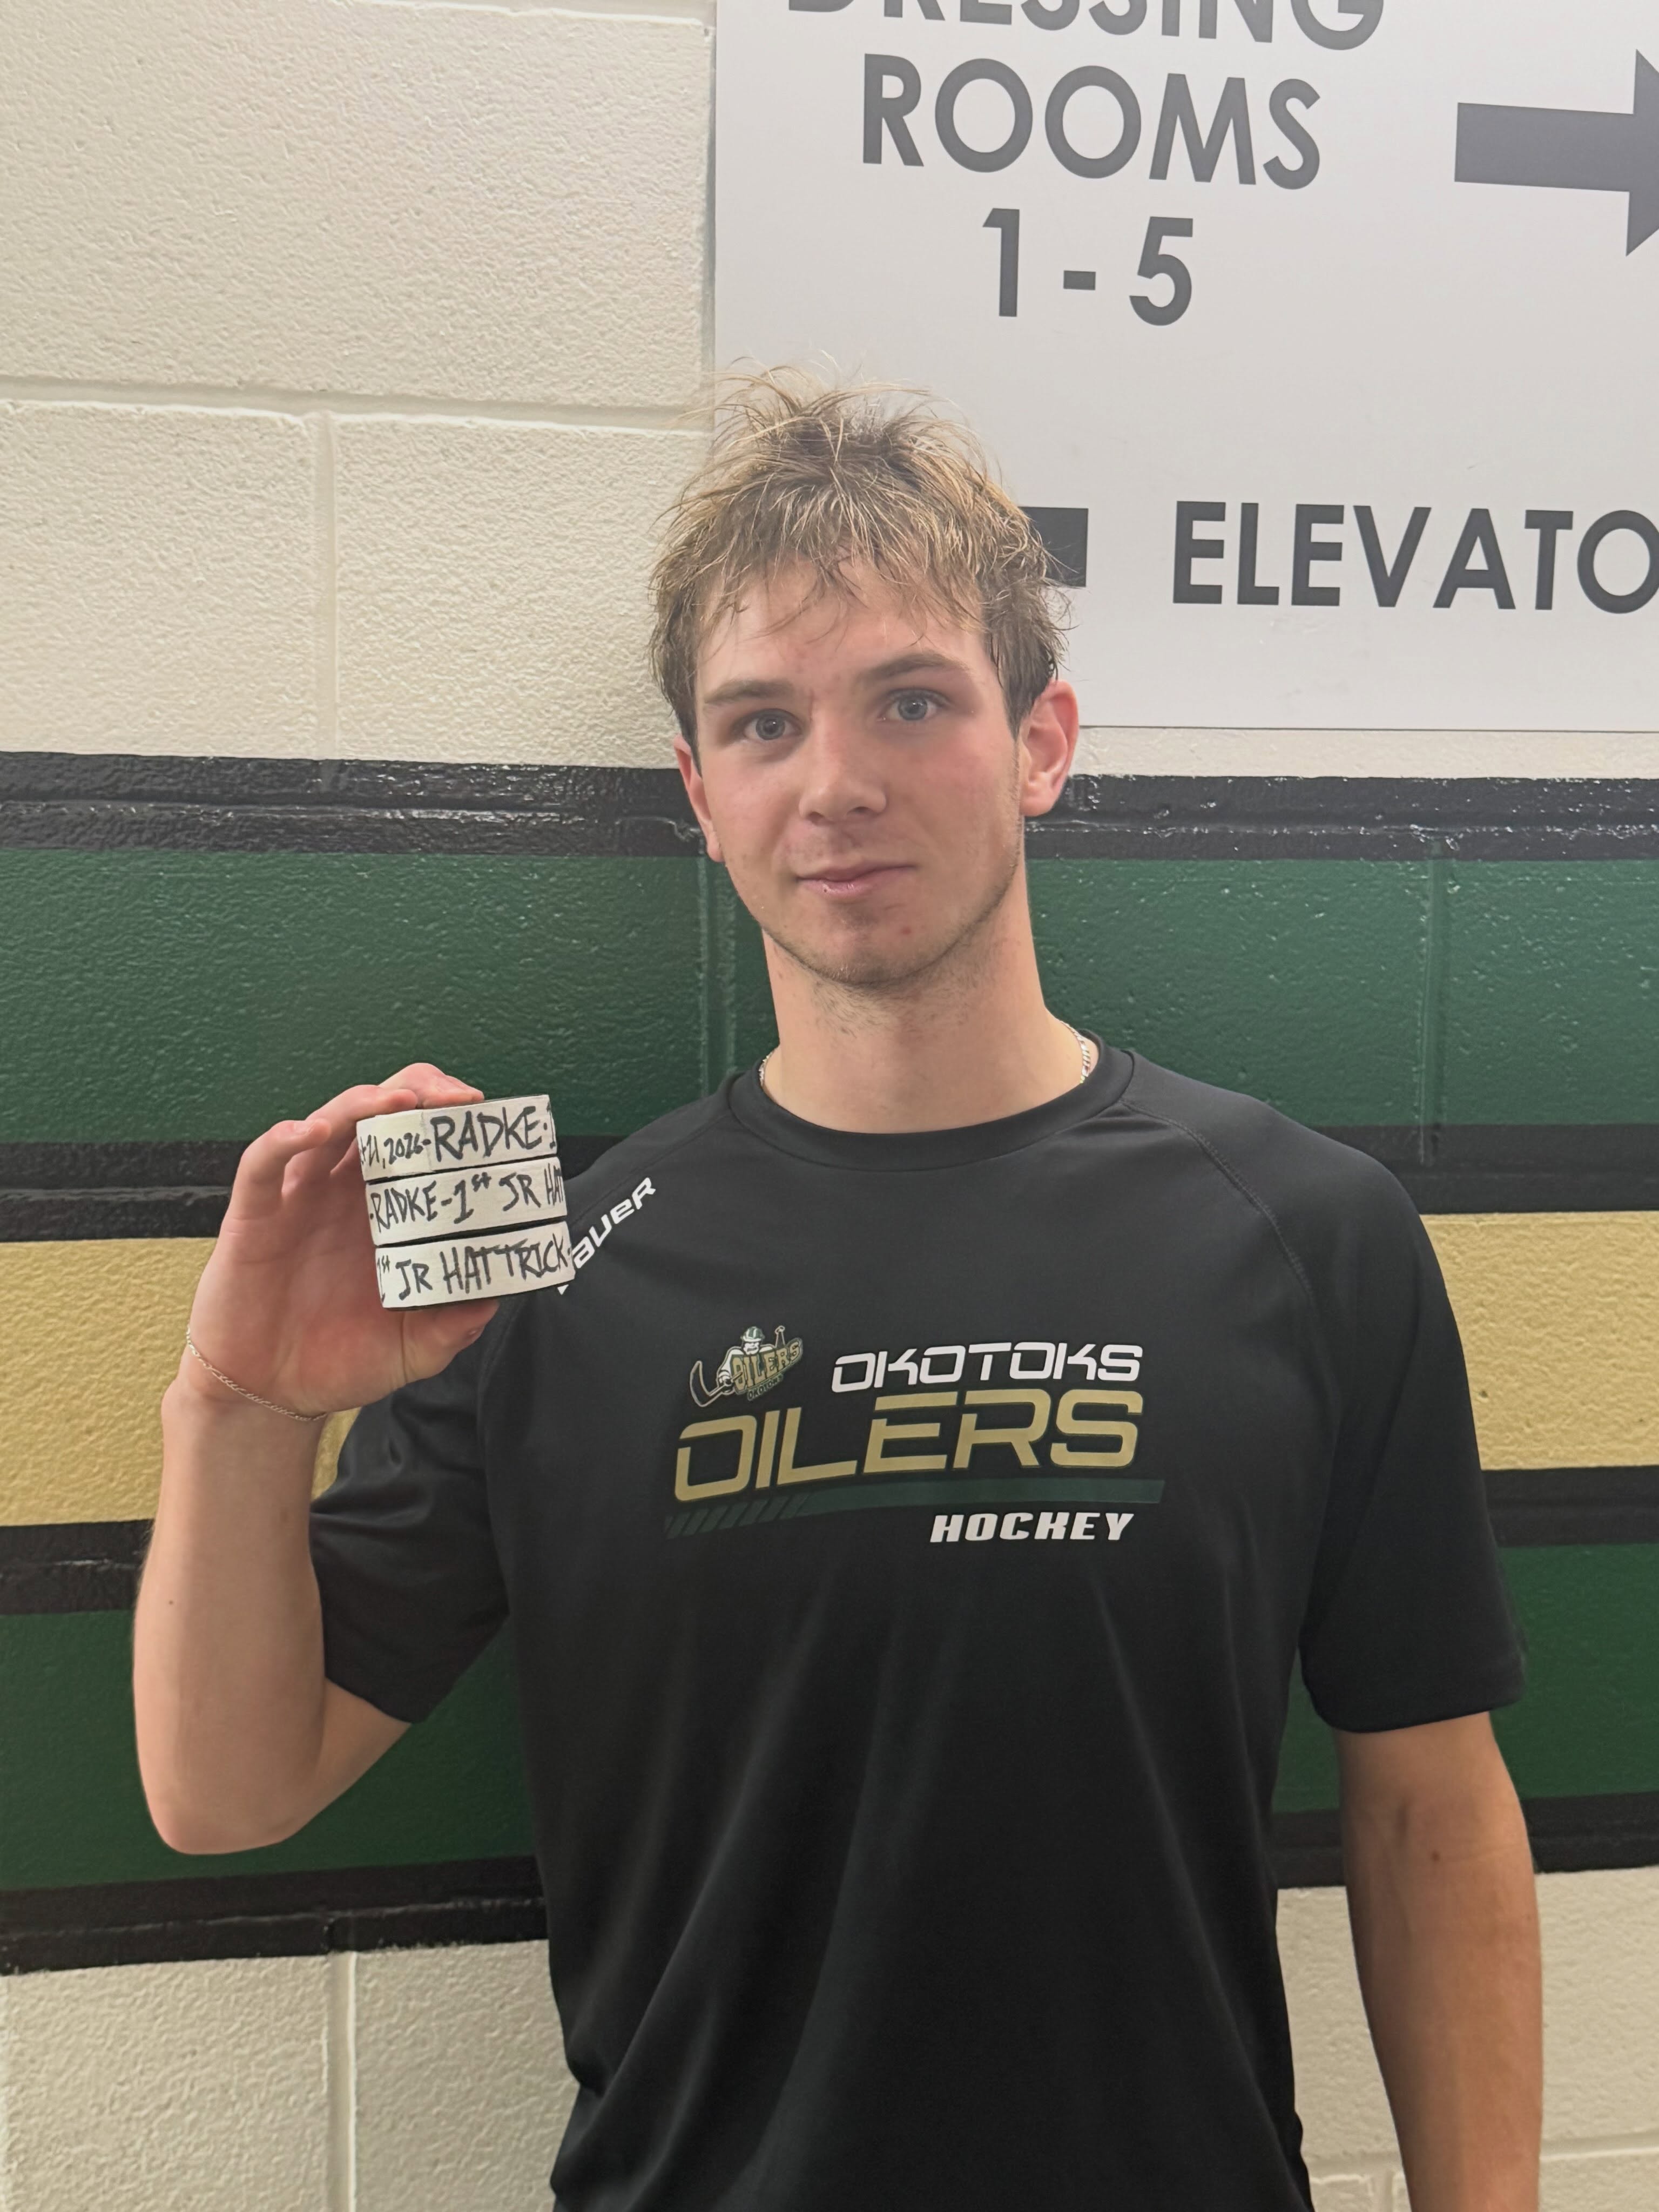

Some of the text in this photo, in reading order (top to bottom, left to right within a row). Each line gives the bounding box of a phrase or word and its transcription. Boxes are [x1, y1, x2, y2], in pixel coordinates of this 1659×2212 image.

[862, 53, 1321, 190] ROOMS
[983, 208, 1020, 318] 1
[1129, 216, 1193, 326] 5
[1172, 501, 1659, 615] ELEVATO
[498, 1171, 542, 1212] JR
[557, 1177, 657, 1295] AUER
[395, 1258, 433, 1301] JR
[731, 1340, 801, 1392] OILERS
[832, 1341, 1143, 1393] OKOTOKS
[674, 1388, 1144, 1501] OILERS
[929, 1512, 1135, 1543] HOCKEY
